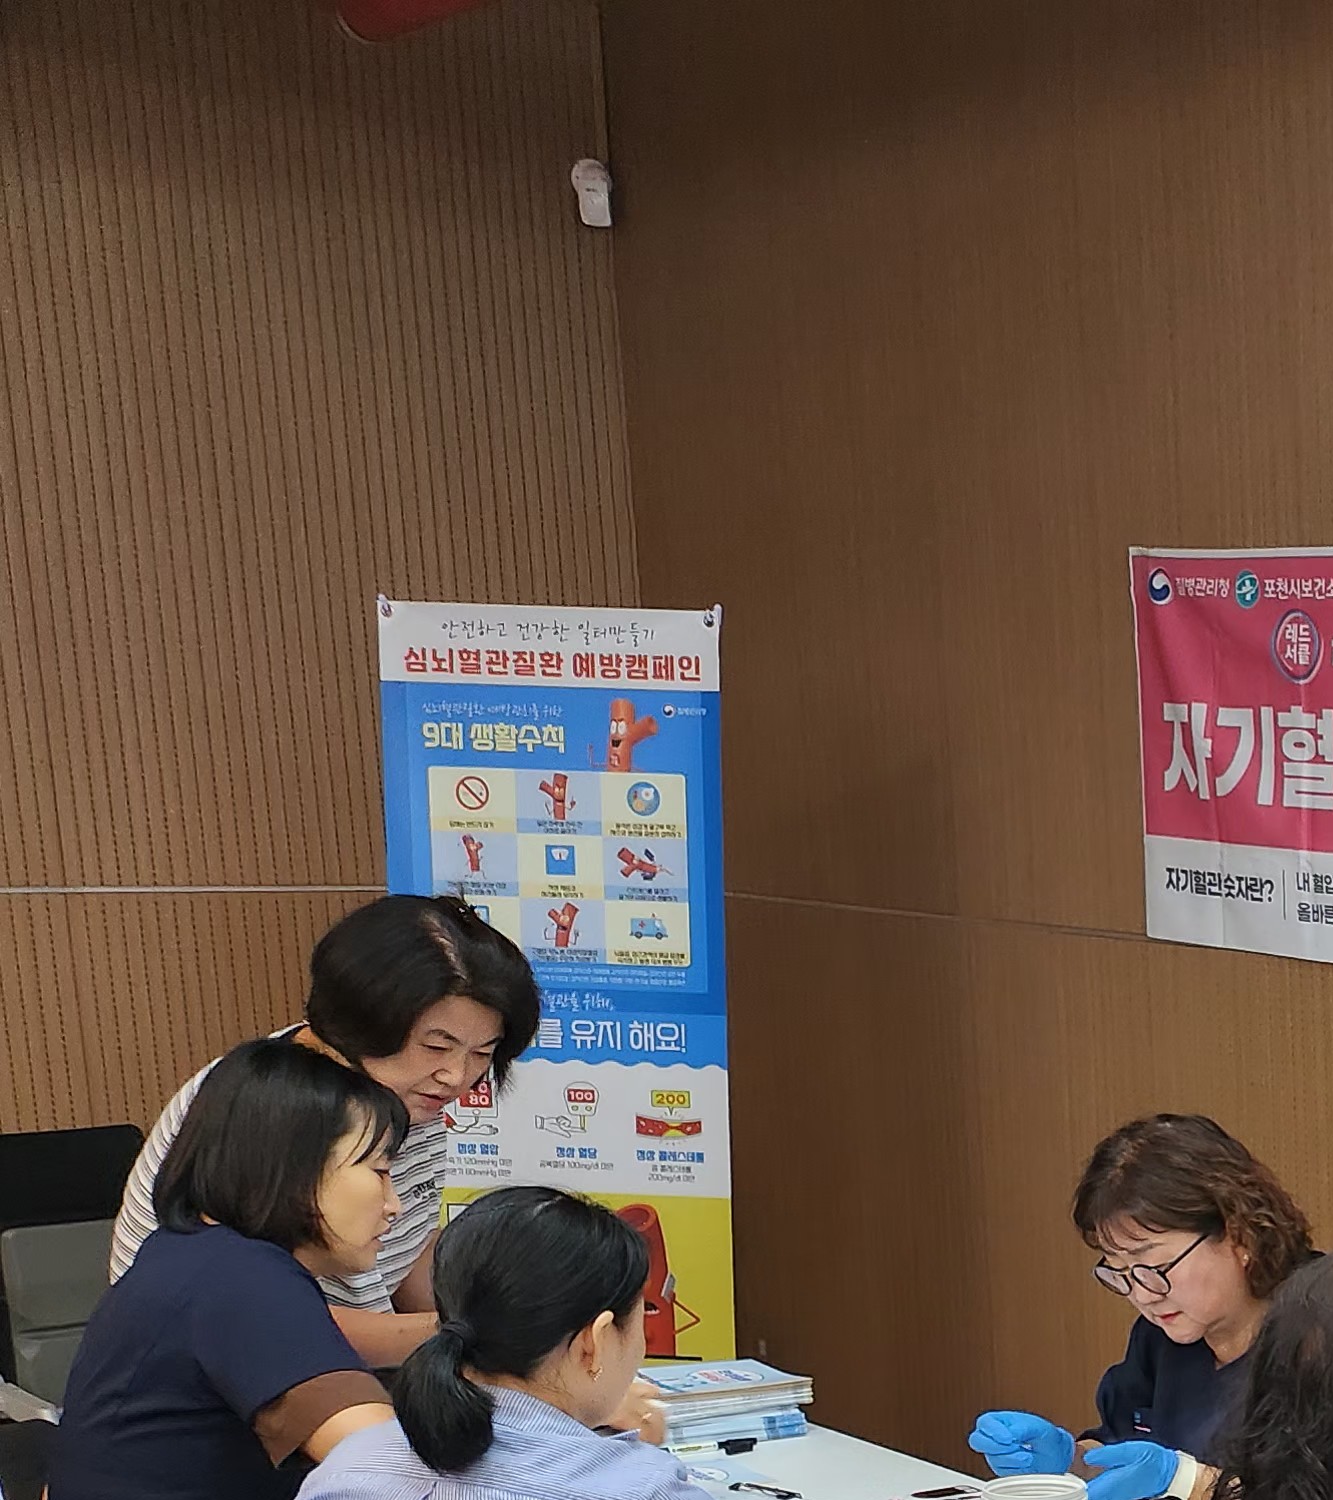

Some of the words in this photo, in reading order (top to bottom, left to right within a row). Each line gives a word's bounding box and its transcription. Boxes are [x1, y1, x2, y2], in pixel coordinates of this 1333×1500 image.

[1175, 577, 1230, 598] 질병관리청
[441, 618, 508, 641] 안전하고
[516, 621, 571, 643] 건강한
[578, 619, 656, 648] 일터만들기
[1285, 623, 1311, 643] 레드
[403, 646, 564, 678] 심뇌혈관질환
[572, 651, 701, 683] 예방캠페인
[1284, 644, 1311, 665] 서클
[422, 721, 464, 750] 9대
[469, 722, 565, 753] 생활수칙
[1296, 871, 1310, 893] 내
[571, 1019, 621, 1050] 유지
[628, 1020, 687, 1053] 해요!
[469, 1093, 490, 1105] 80
[569, 1090, 594, 1101] 100
[655, 1093, 687, 1105] 200
